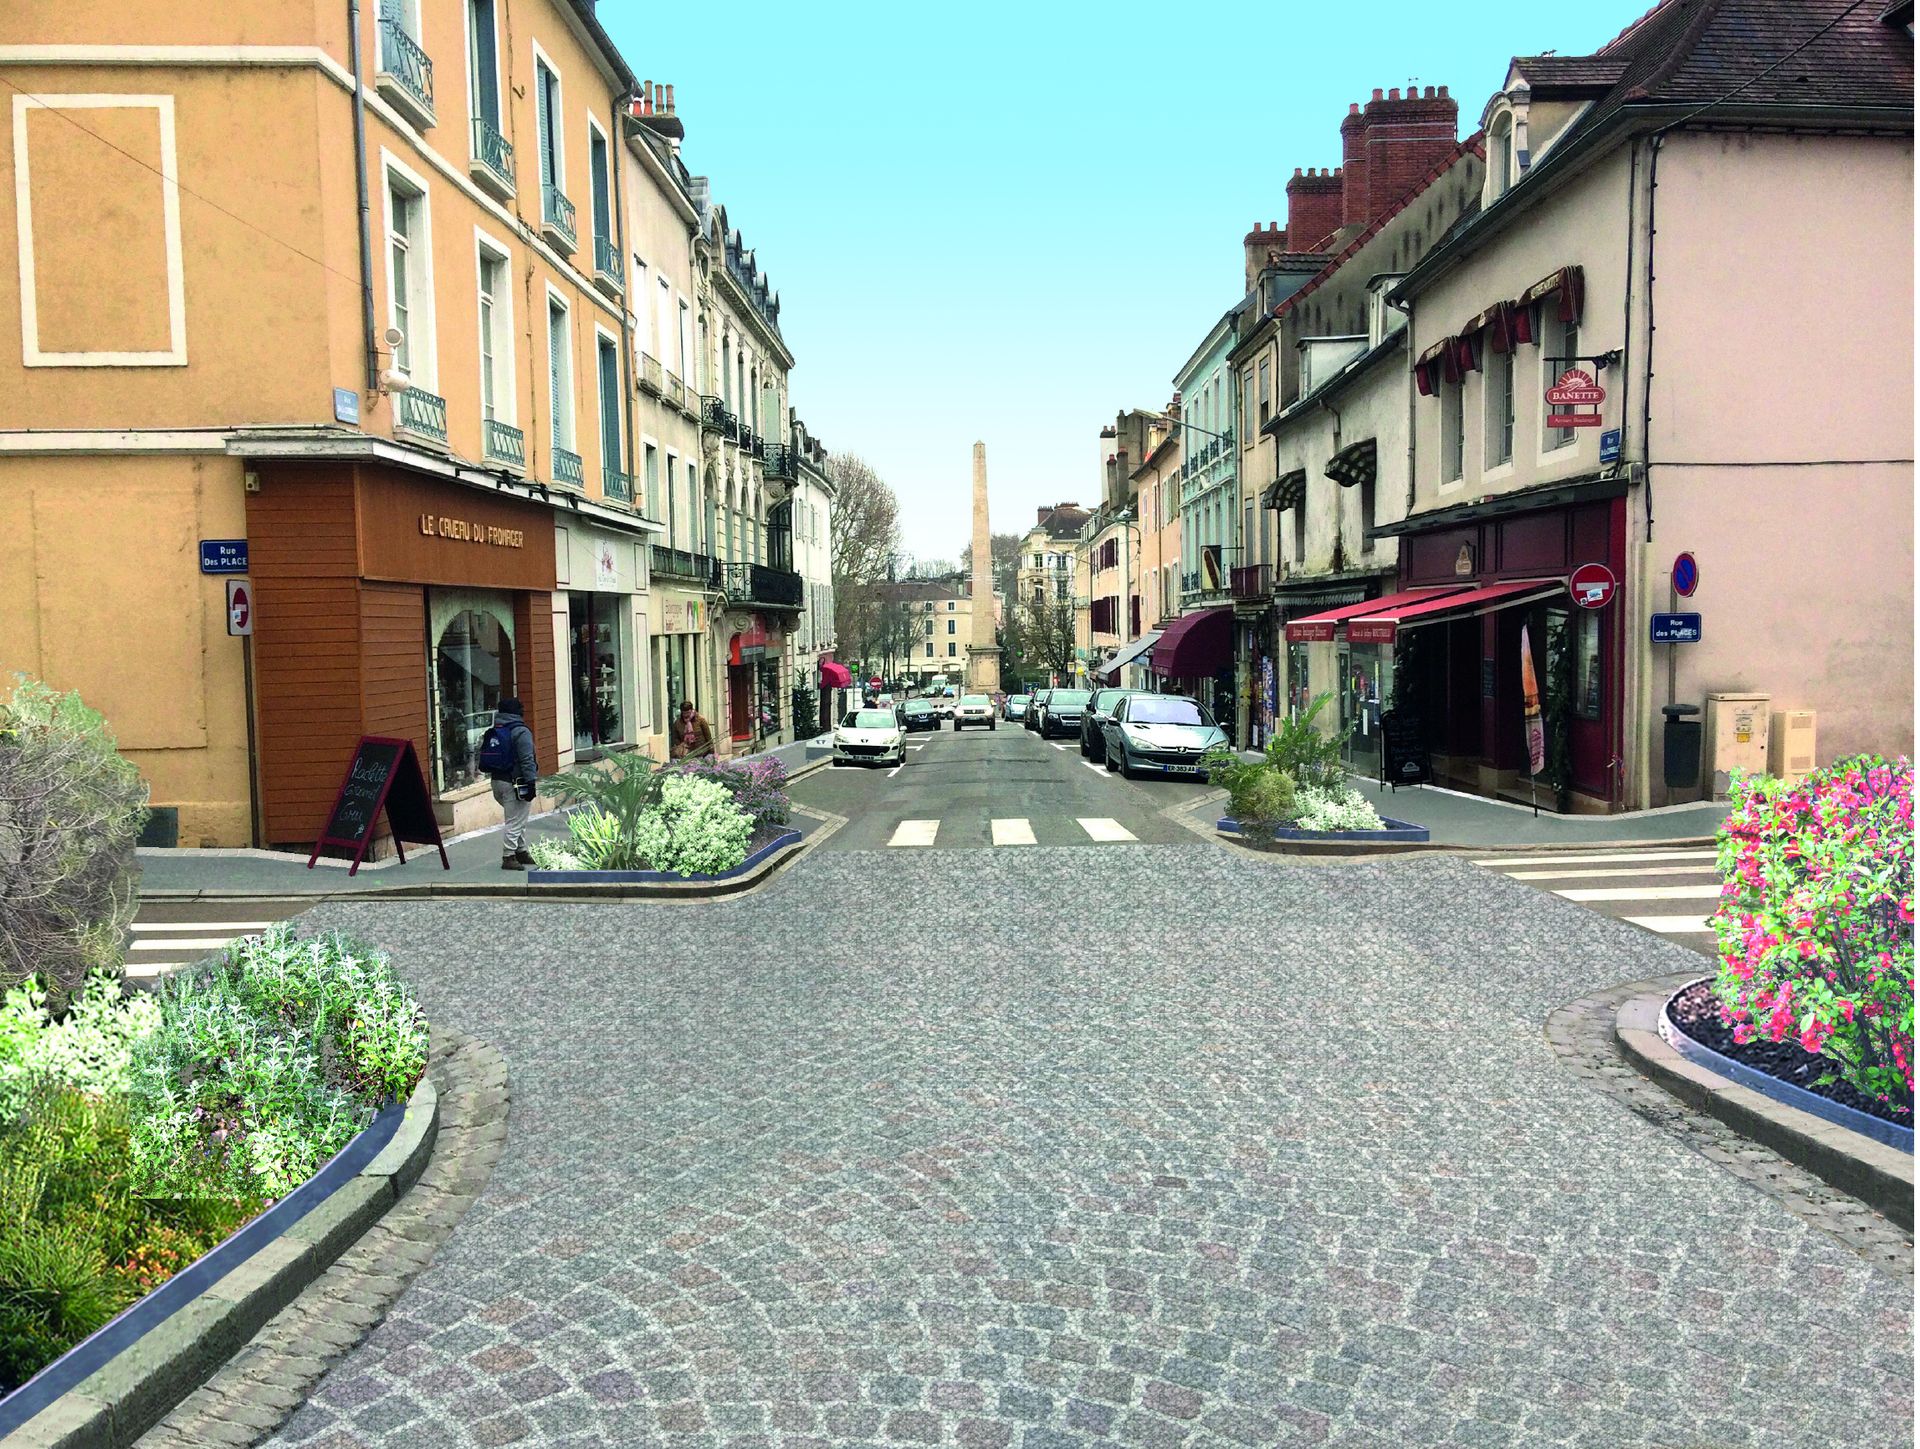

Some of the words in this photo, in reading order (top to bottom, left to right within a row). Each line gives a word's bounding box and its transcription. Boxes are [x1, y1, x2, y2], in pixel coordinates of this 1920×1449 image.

[1552, 391, 1599, 400] BANETTE
[421, 513, 434, 536] LE
[438, 517, 470, 541] CAVEAU
[473, 523, 484, 543] DU
[488, 526, 524, 549] FROMAGER
[220, 546, 236, 555] Rue
[204, 558, 218, 566] Des
